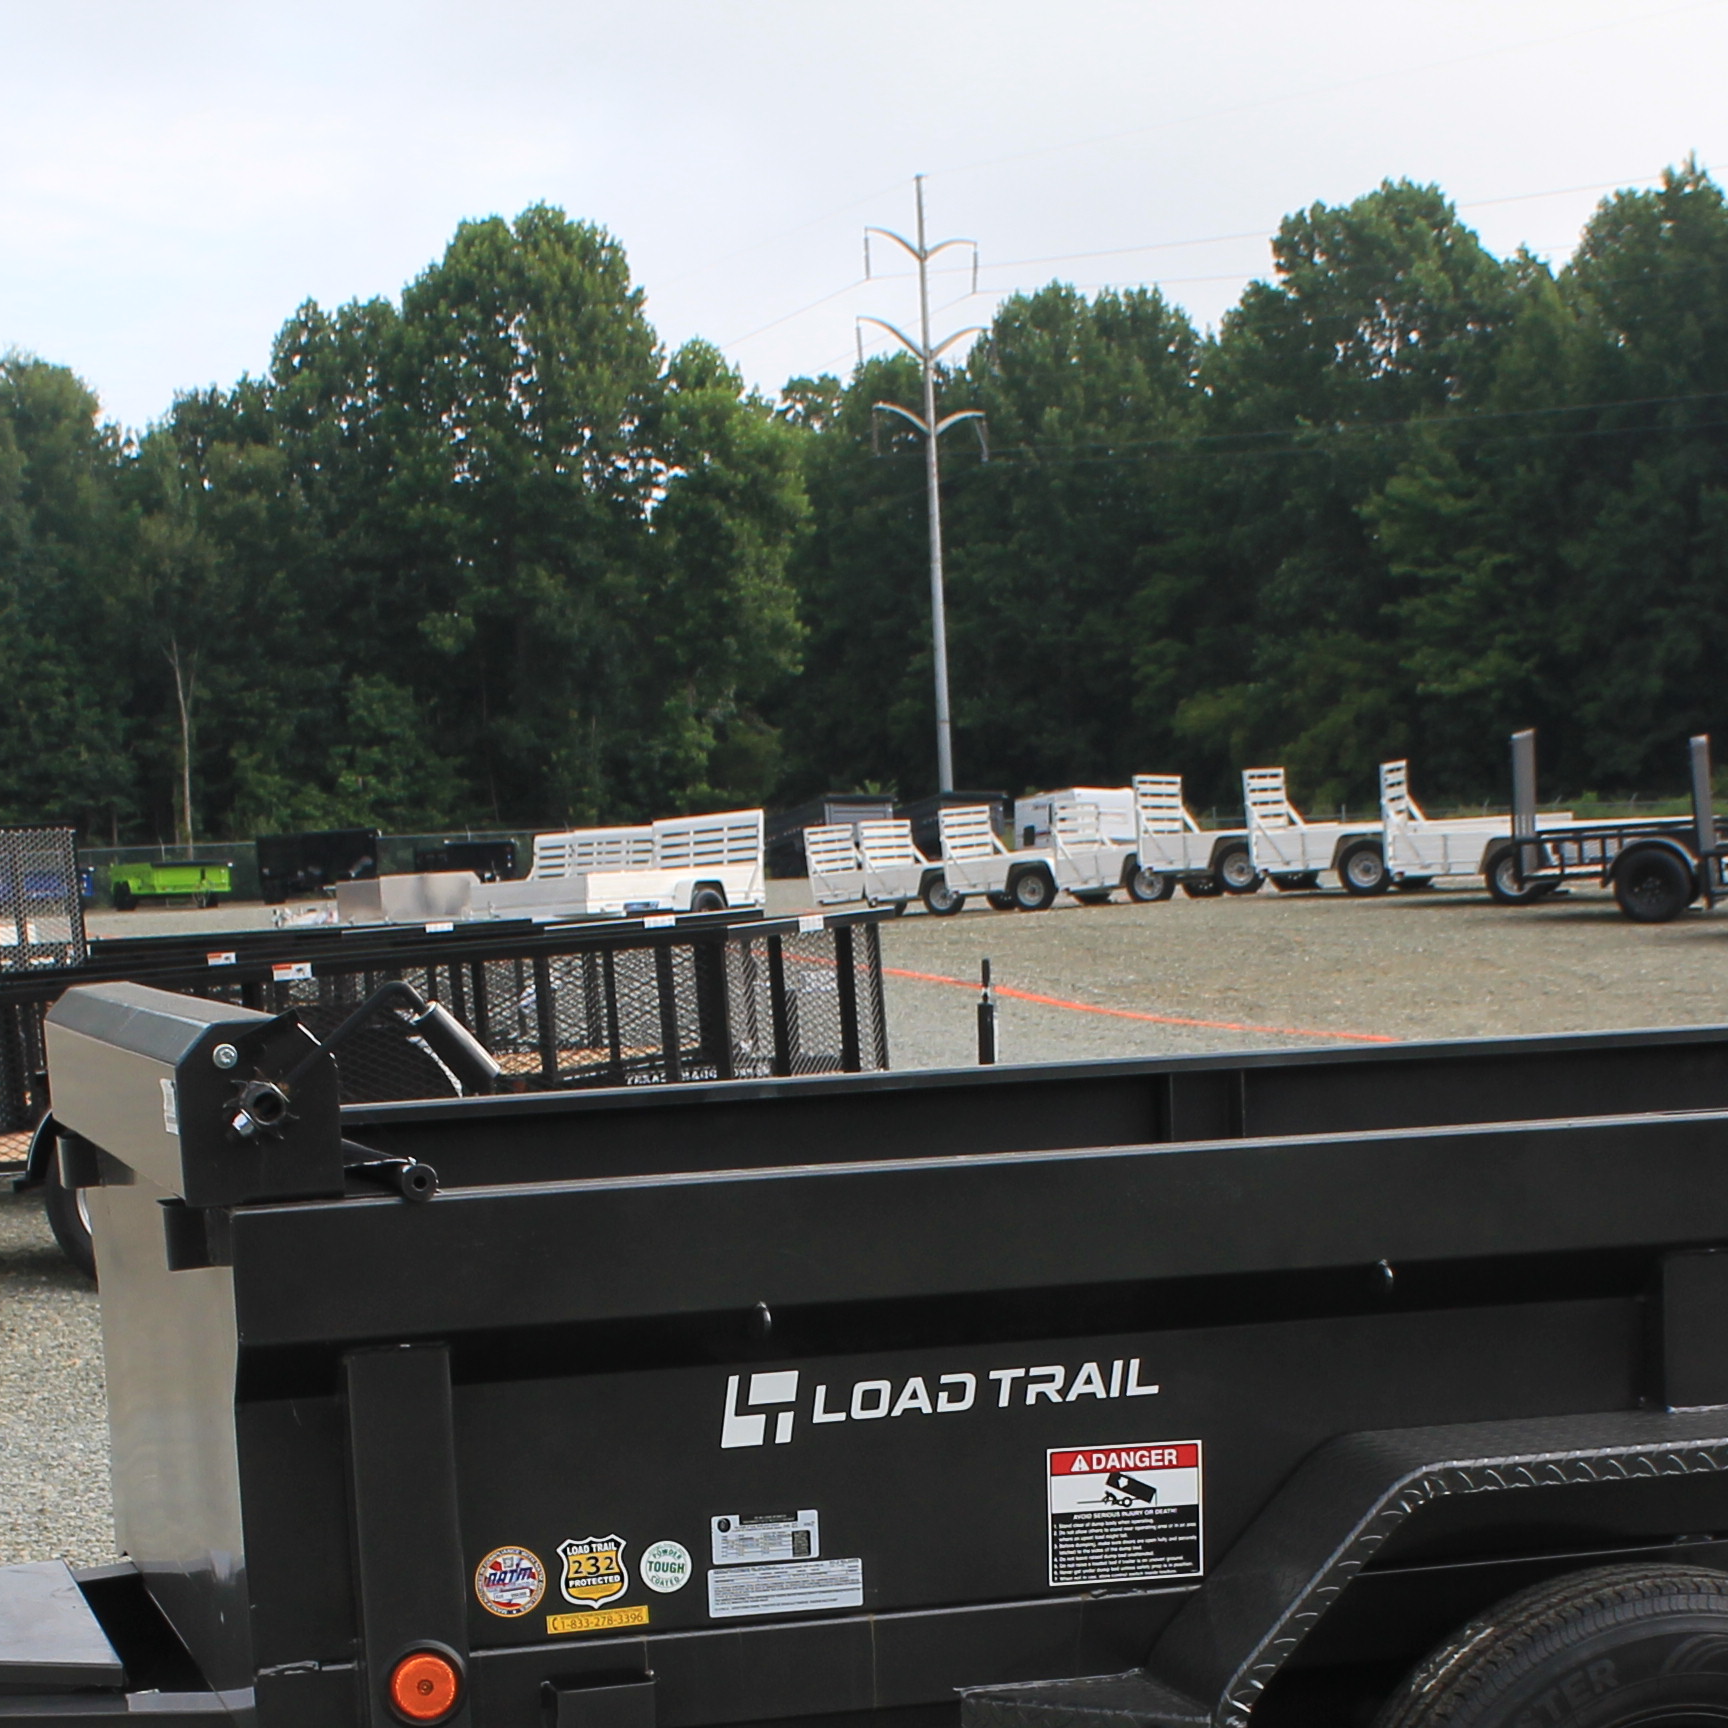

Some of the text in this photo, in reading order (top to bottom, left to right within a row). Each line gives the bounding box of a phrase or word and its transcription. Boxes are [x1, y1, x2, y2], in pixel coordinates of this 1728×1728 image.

[812, 1358, 1159, 1424] LOAD TRAIL
[1092, 1449, 1178, 1470] DANGER
[566, 1541, 618, 1556] LOAD TRAIL
[652, 1548, 682, 1560] POWDER
[572, 1556, 615, 1575] 232
[647, 1560, 685, 1573] TOUGH
[568, 1575, 621, 1588] PROTECTED
[651, 1575, 680, 1586] COATED
[560, 1612, 644, 1630] 1-833-278-3396
